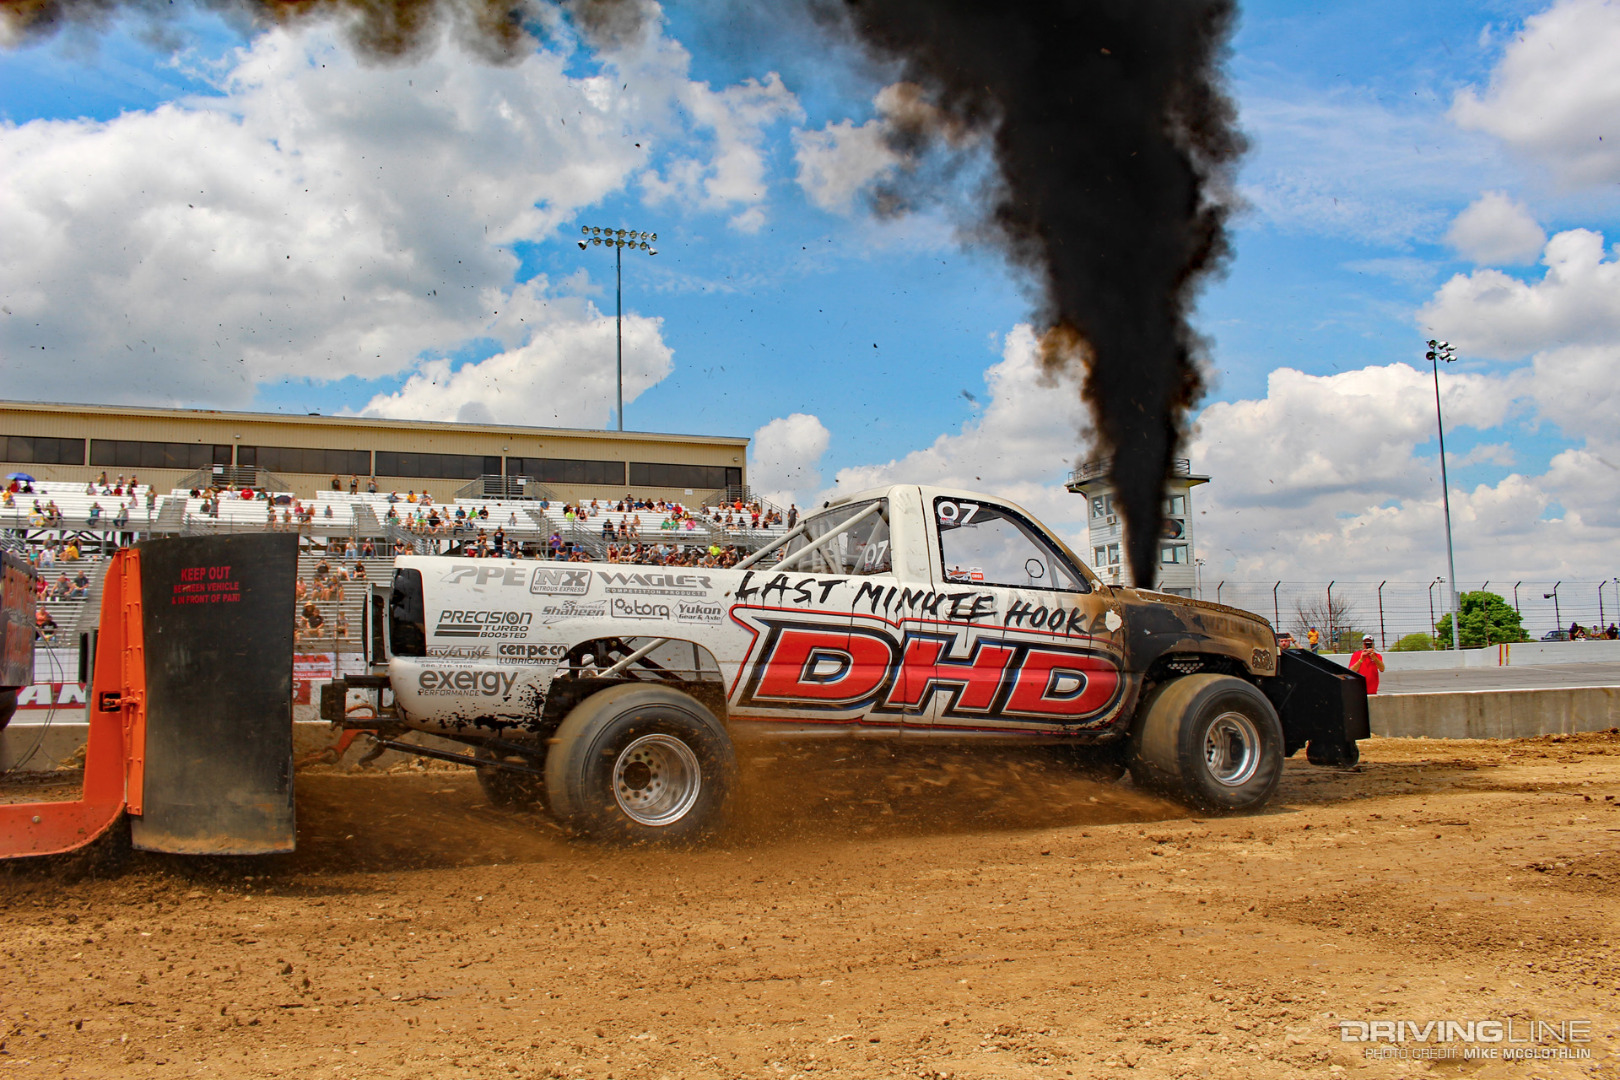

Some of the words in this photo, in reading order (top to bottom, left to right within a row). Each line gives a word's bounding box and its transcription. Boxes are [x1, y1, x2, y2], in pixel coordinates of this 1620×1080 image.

[937, 501, 980, 524] 07
[865, 540, 889, 565] 07
[181, 567, 206, 581] KEEP
[208, 566, 231, 580] OUT
[441, 565, 527, 587] PPE
[534, 570, 589, 586] NX
[597, 571, 713, 589] WAGLER
[174, 584, 206, 593] BETWEEN
[207, 582, 240, 591] VEHICLE
[178, 596, 185, 604] IN
[186, 595, 210, 604] FRONT
[211, 594, 221, 603] OF
[734, 571, 849, 608] LAST
[851, 581, 998, 620] MINUTE
[541, 605, 606, 617] Shaheen
[678, 604, 721, 615] Yukon
[439, 610, 533, 625] PRECISION
[480, 631, 528, 639] BOOSTED
[499, 657, 558, 665] LUBRICANTS
[736, 616, 1124, 722] DHD
[418, 670, 519, 697] exergy
[418, 689, 480, 697] PERFORMANCE
